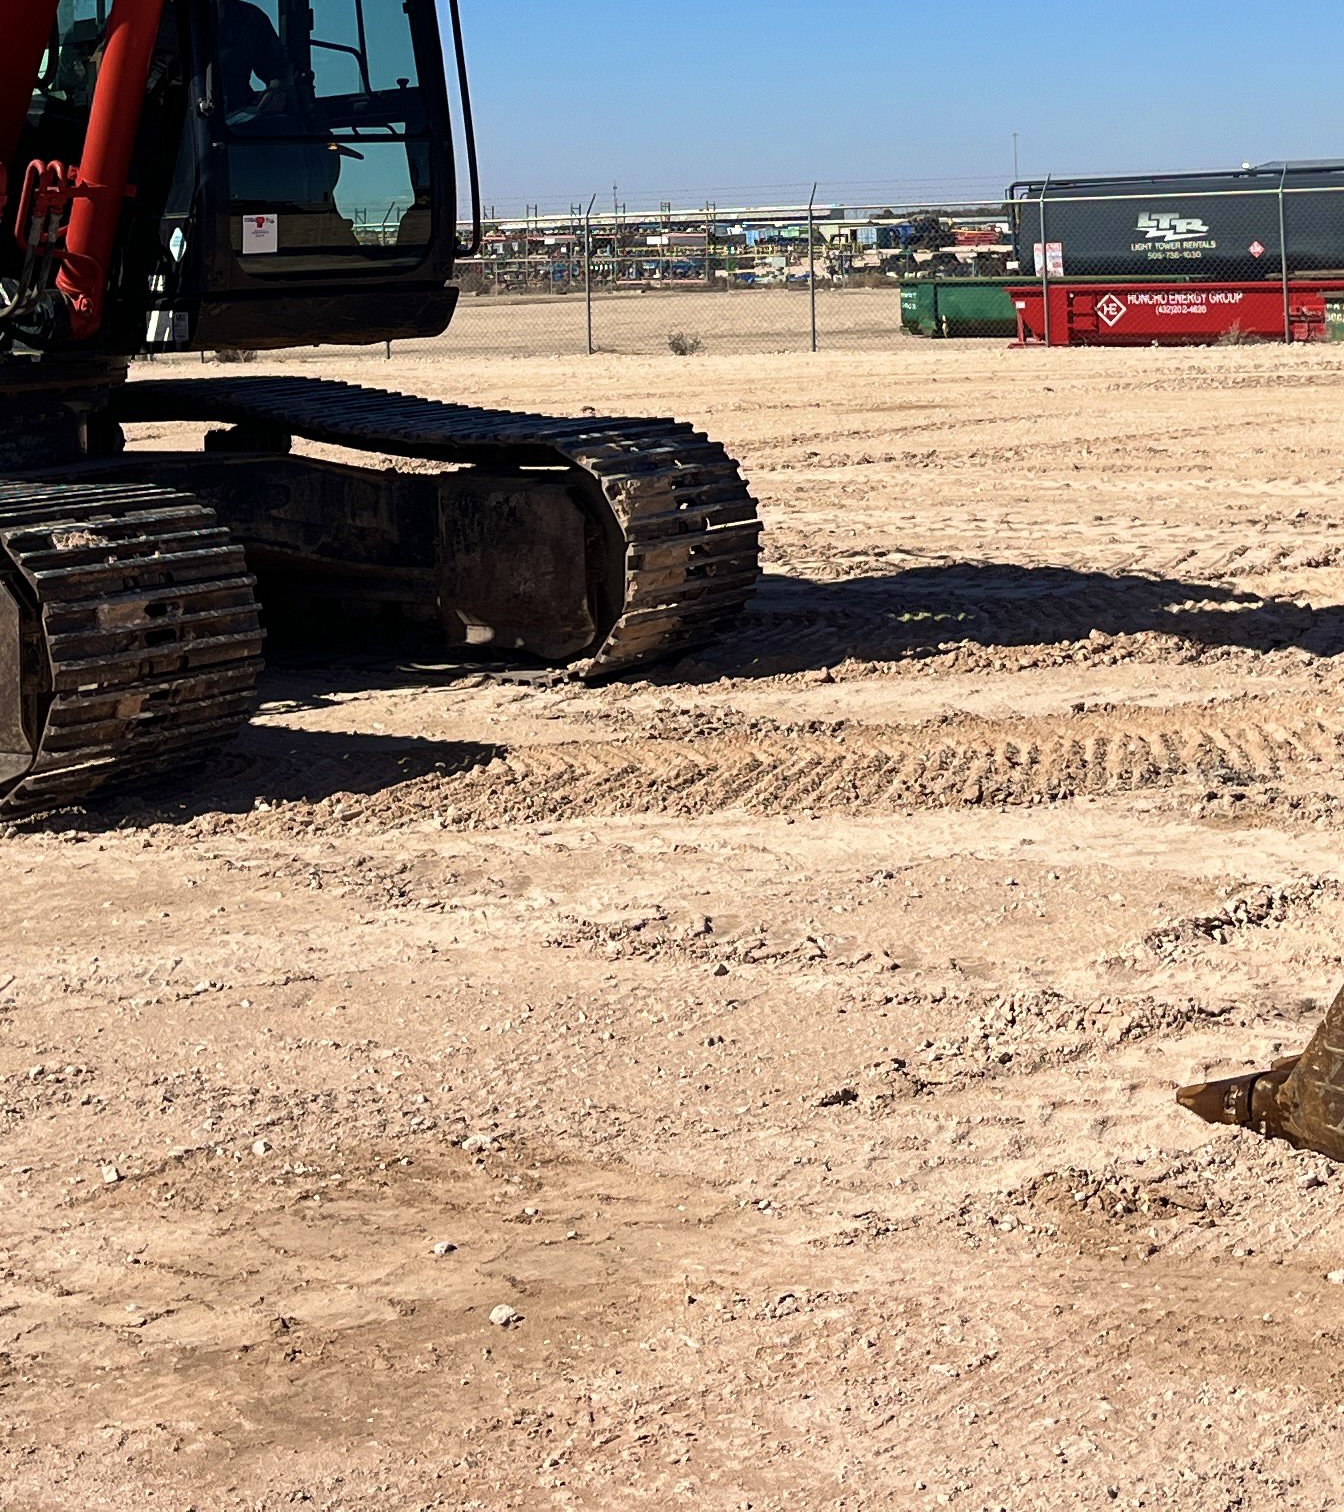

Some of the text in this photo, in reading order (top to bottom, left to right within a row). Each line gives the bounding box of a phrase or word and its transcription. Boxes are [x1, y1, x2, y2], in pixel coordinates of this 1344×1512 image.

[1137, 211, 1209, 233] LTR
[1130, 240, 1216, 251] LIGHT TOWER RENTALS
[1169, 291, 1207, 305] ENERGY
[1208, 290, 1244, 304] GROUP
